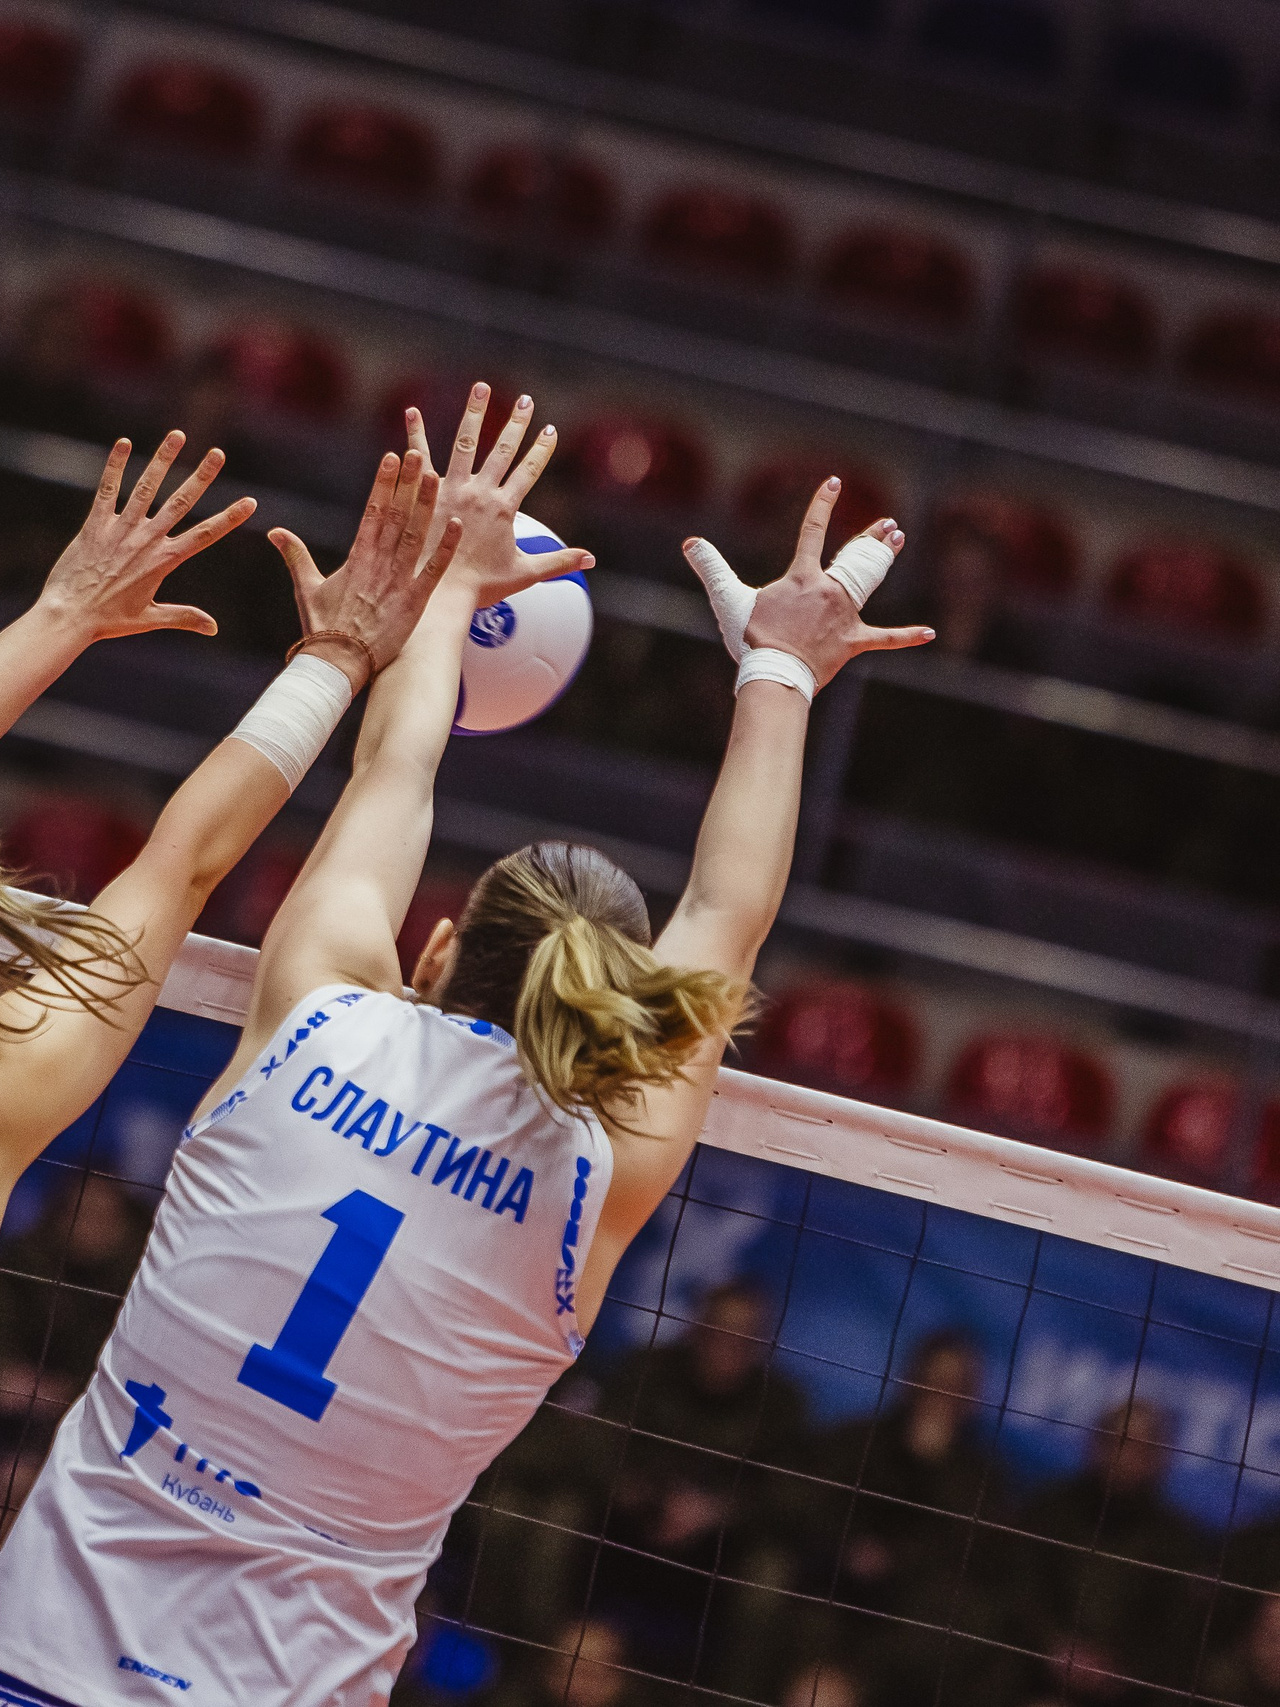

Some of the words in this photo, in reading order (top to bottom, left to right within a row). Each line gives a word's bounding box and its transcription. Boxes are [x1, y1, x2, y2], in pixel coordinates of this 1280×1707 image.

[290, 1066, 536, 1225] СЛАУТИНА
[237, 1189, 406, 1422] 1
[161, 1473, 236, 1524] Кубань
